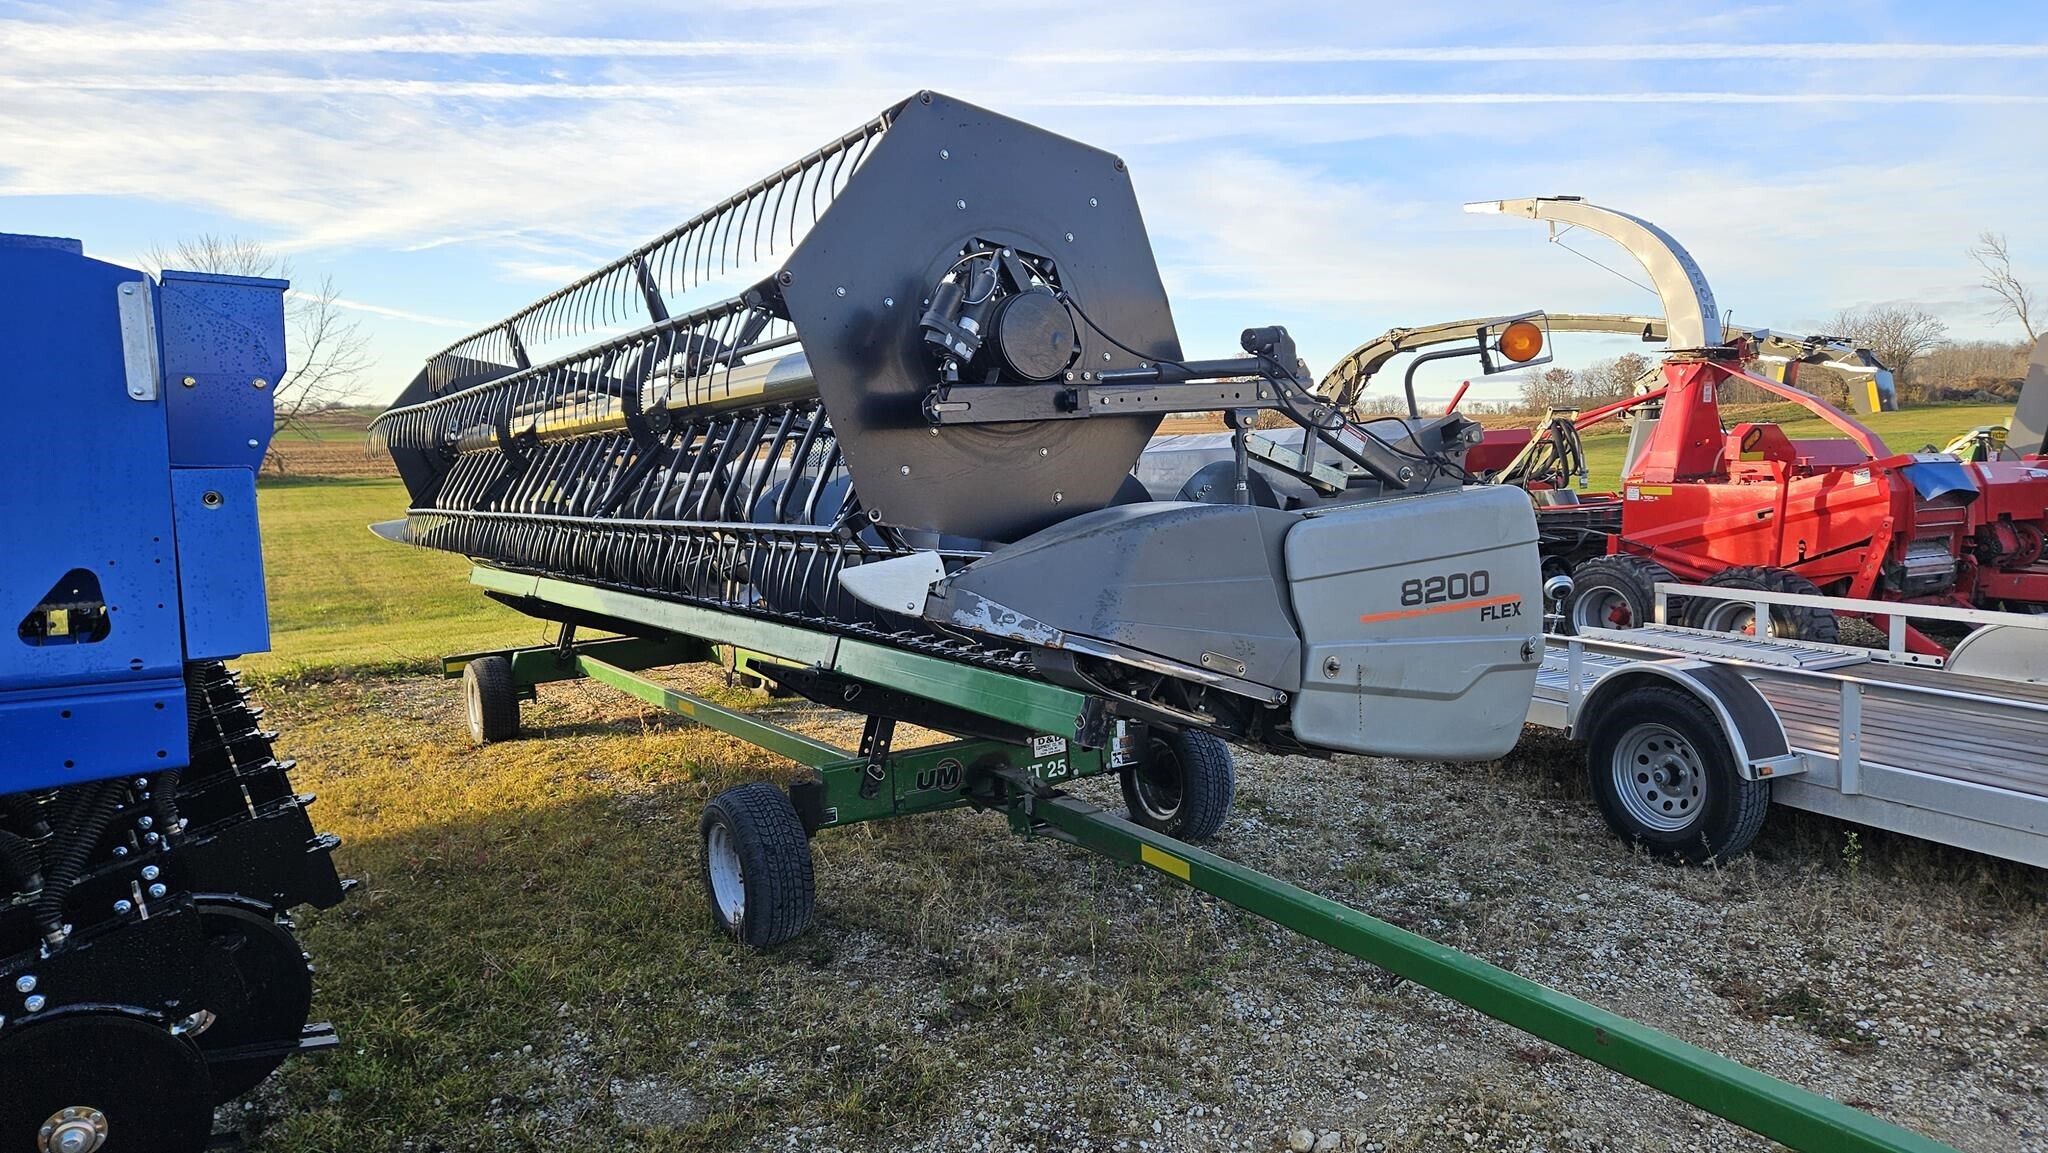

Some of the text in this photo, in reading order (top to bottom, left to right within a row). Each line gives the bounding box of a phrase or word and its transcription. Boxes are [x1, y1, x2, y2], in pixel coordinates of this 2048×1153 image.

[1401, 570, 1490, 606] 8200
[1481, 601, 1521, 622] FLEX
[1038, 736, 1060, 745] D&D
[1047, 759, 1067, 778] 25
